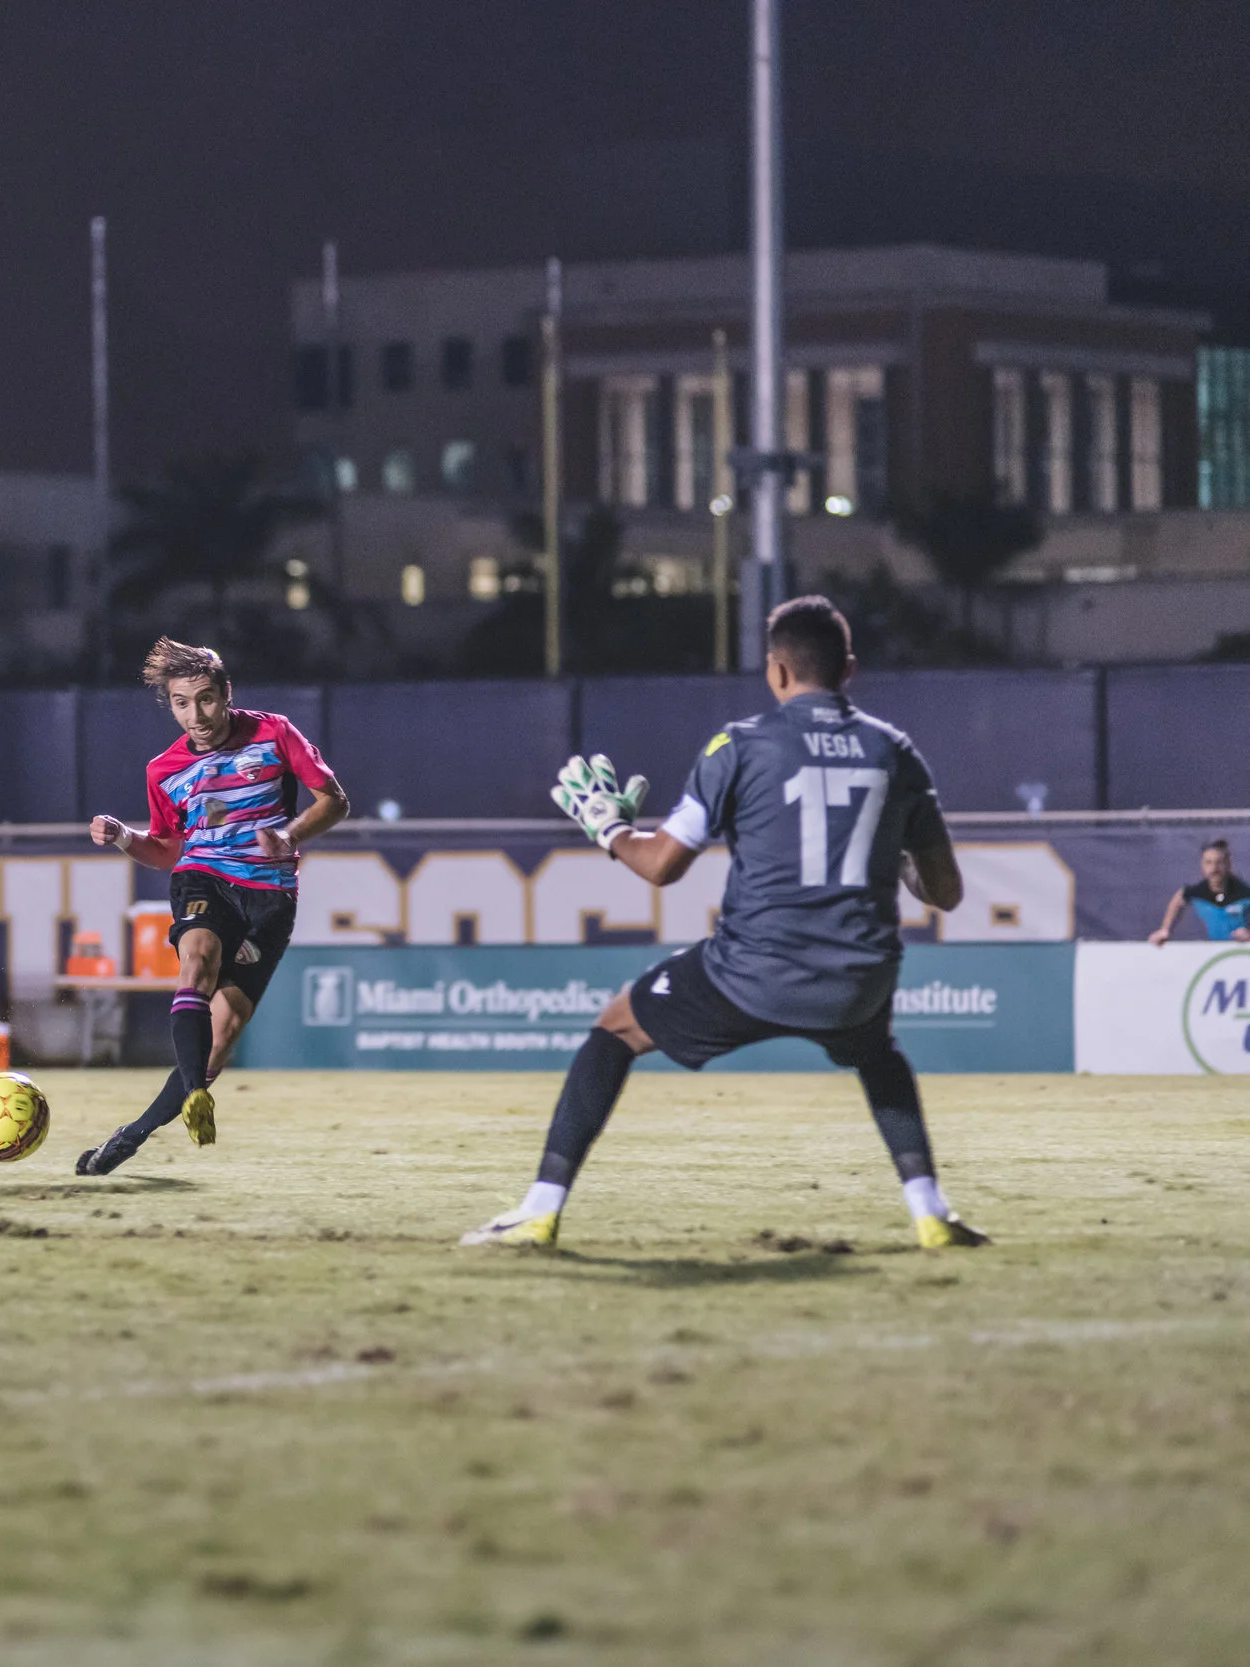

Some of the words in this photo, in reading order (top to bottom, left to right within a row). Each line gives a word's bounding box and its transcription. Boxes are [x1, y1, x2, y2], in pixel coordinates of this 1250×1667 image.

[803, 732, 866, 758] VEGA
[784, 766, 889, 887] 17
[356, 979, 445, 1014] Miami
[449, 979, 613, 1022] Orthopedics
[893, 980, 997, 1014] nstitute
